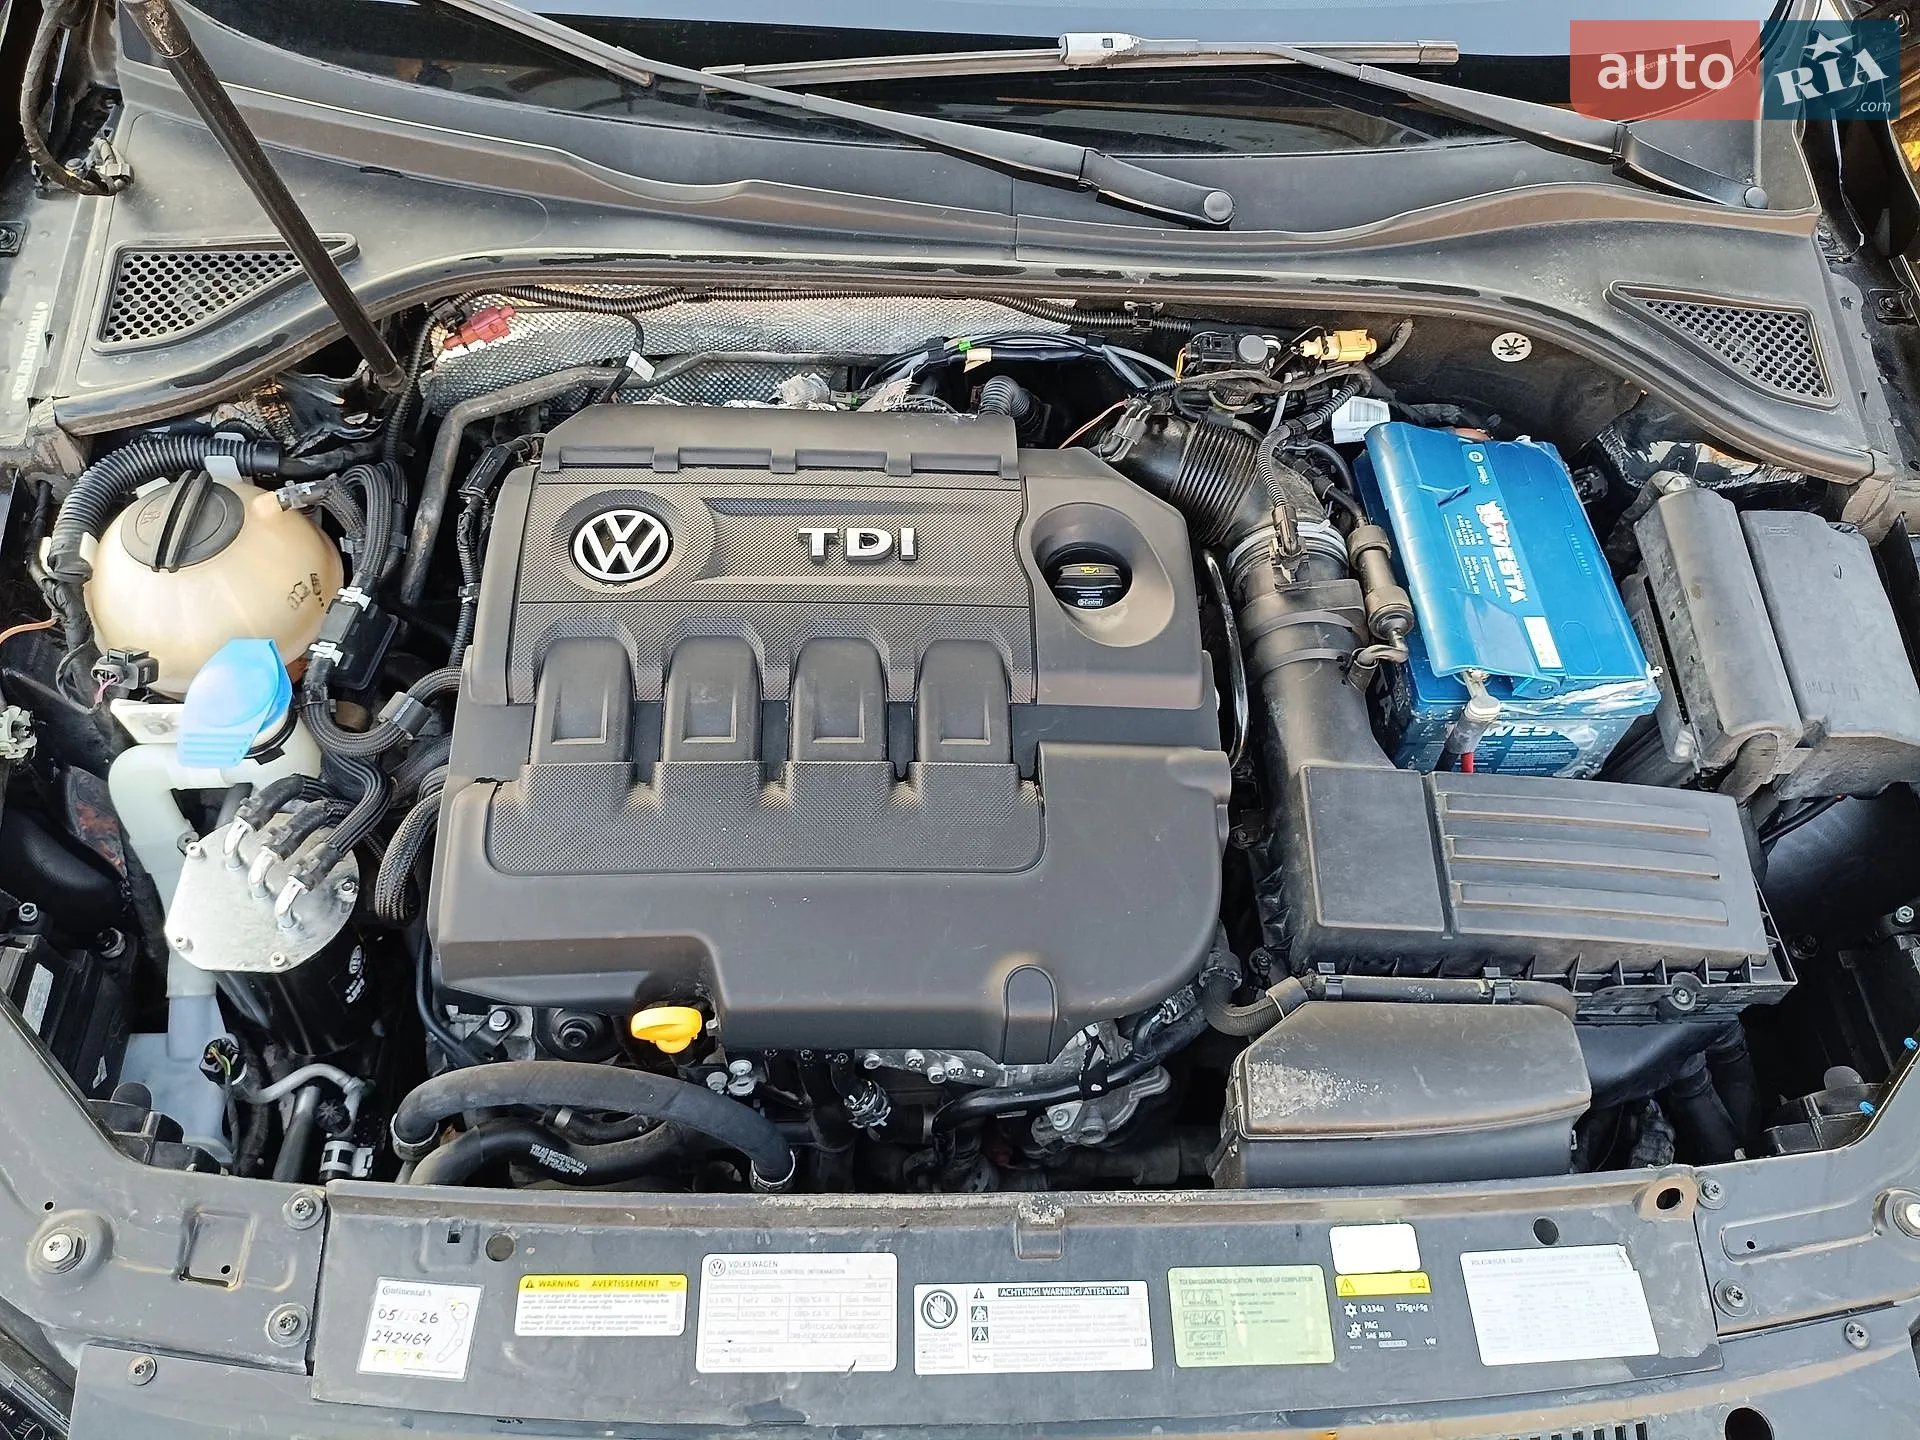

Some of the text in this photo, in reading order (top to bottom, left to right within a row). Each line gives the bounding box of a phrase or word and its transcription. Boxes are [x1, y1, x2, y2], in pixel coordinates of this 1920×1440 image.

[798, 526, 919, 564] TDI
[538, 1279, 660, 1288] WARNING AVERTISSEMENT
[382, 1286, 426, 1297] Continental
[1001, 1286, 1128, 1297] ACHTUNG! WARNING! ATTENTION!
